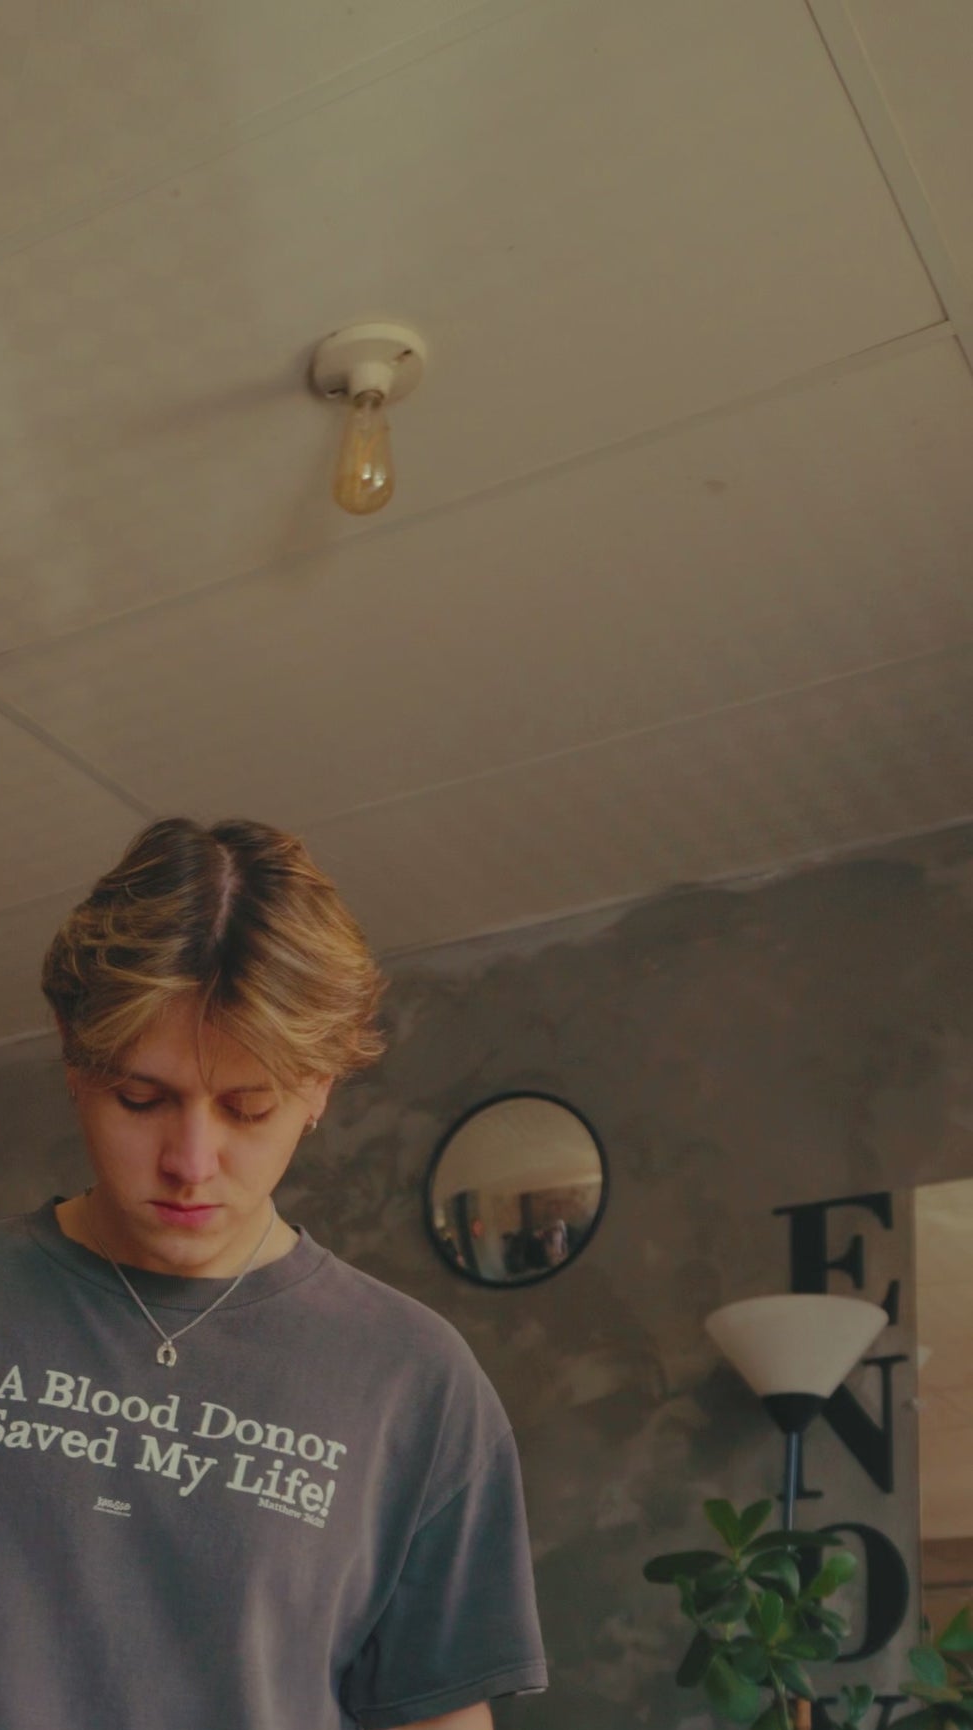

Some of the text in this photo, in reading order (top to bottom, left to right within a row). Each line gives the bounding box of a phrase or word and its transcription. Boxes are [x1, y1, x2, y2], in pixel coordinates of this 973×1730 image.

[37, 1369, 181, 1433] Blood
[192, 1401, 348, 1472] Donor
[133, 1434, 219, 1497] My
[225, 1452, 336, 1517] Life!
[257, 1496, 303, 1519] Matthew
